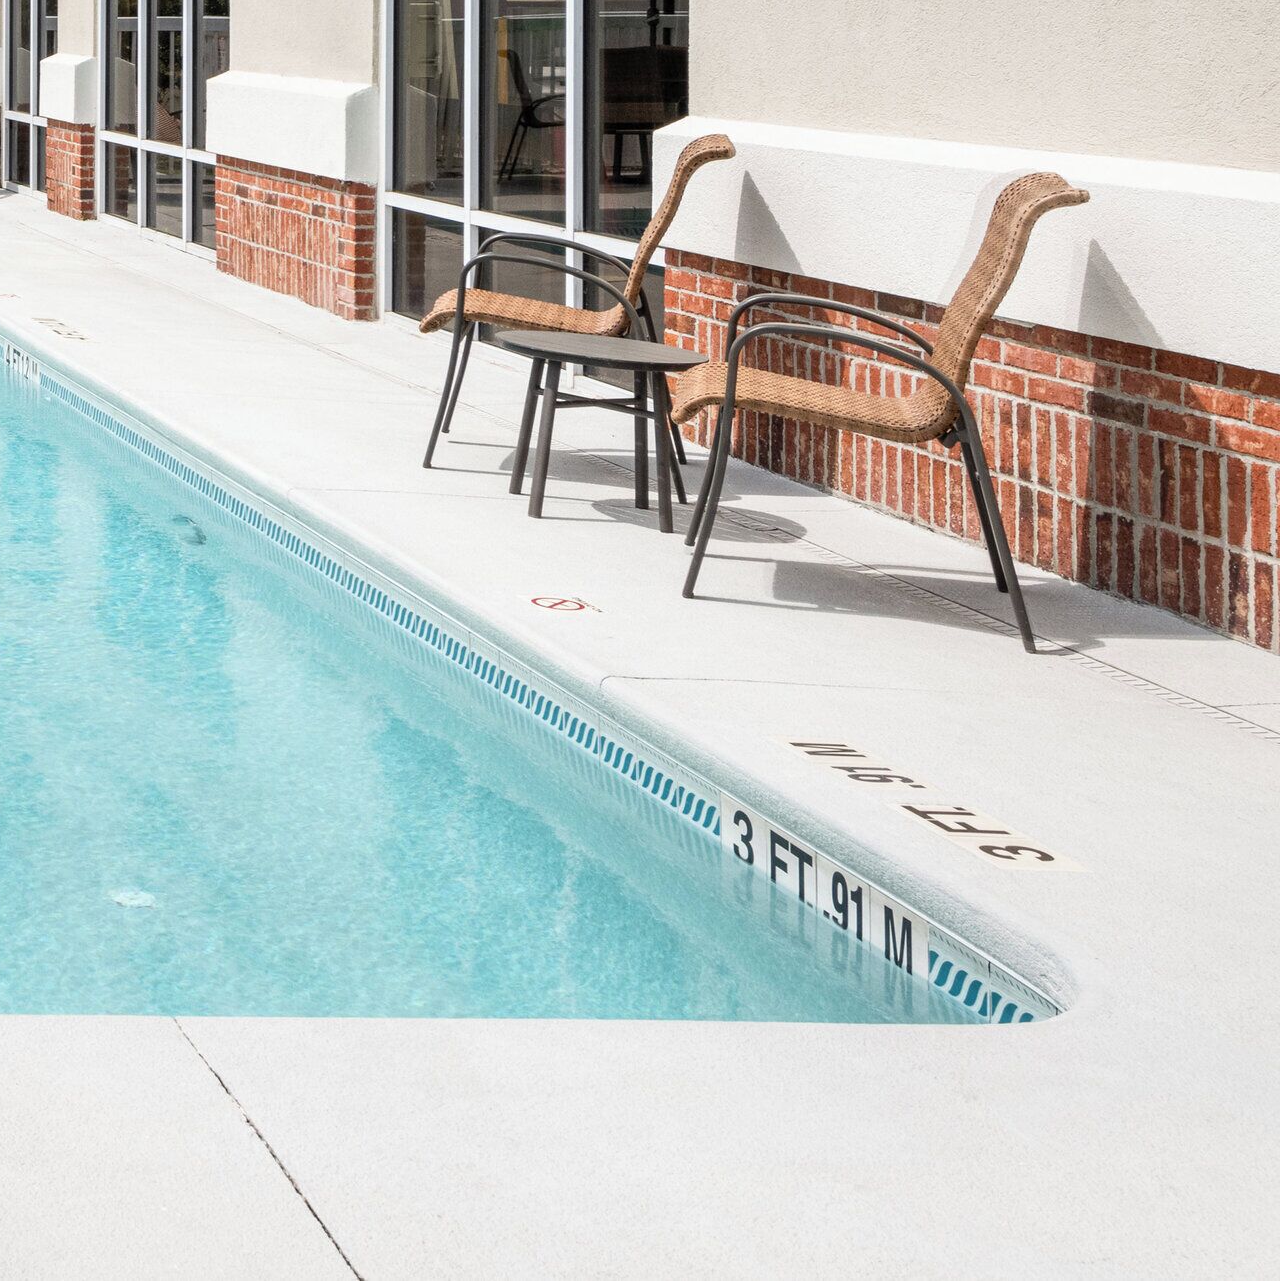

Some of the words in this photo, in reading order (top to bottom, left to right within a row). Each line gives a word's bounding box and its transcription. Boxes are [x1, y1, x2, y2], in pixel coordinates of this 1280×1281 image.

[789, 742, 867, 758] M
[979, 844, 1054, 861] 3
[733, 810, 754, 865] 3
[823, 871, 863, 942] .91
[884, 905, 912, 975] M
